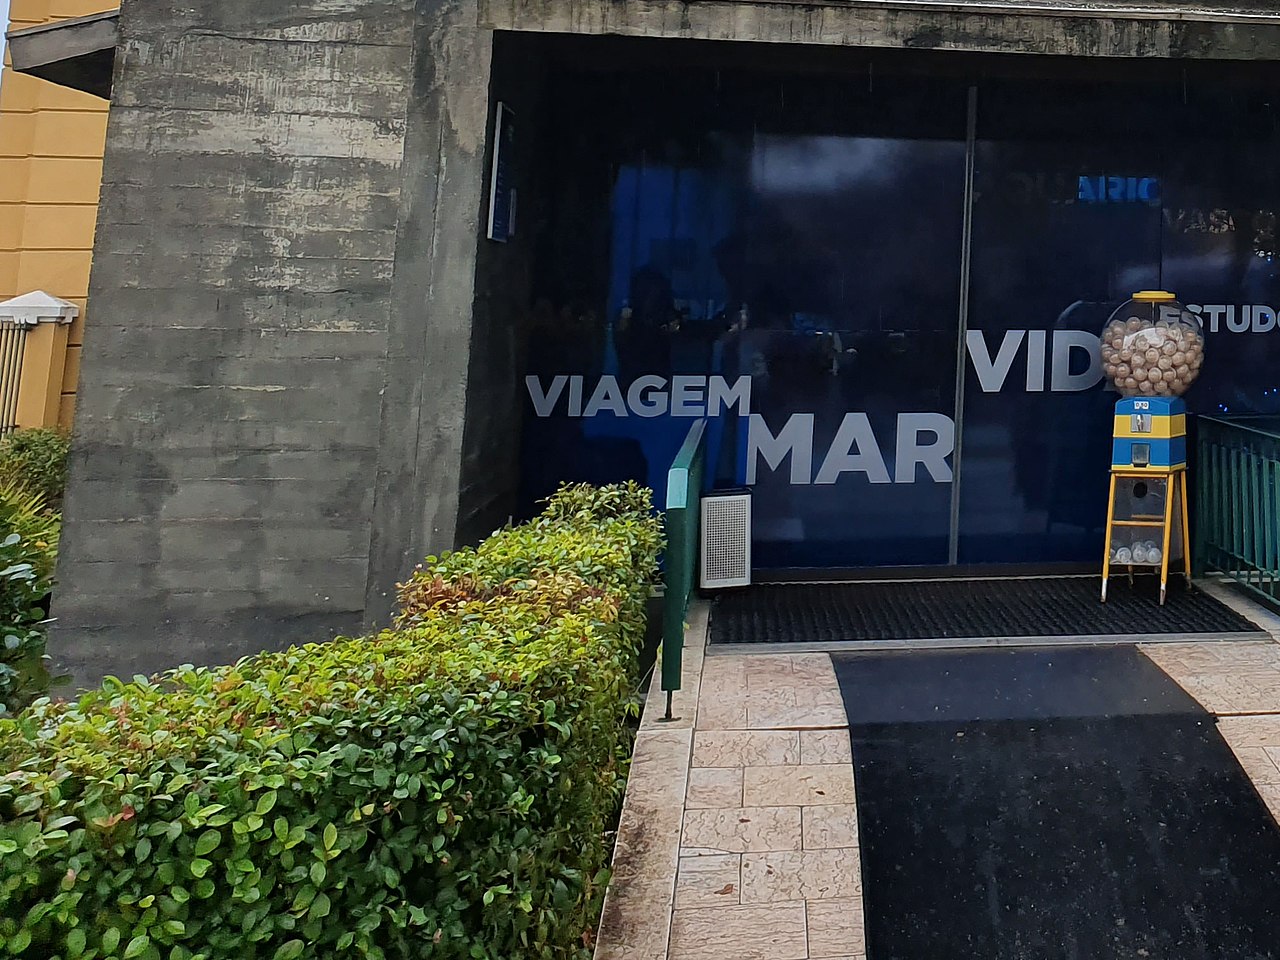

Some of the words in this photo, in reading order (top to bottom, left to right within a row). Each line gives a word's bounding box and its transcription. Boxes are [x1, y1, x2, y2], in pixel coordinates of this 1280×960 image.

[965, 329, 1124, 393] VID
[525, 374, 752, 418] VIAGEM
[745, 412, 958, 486] MAR
